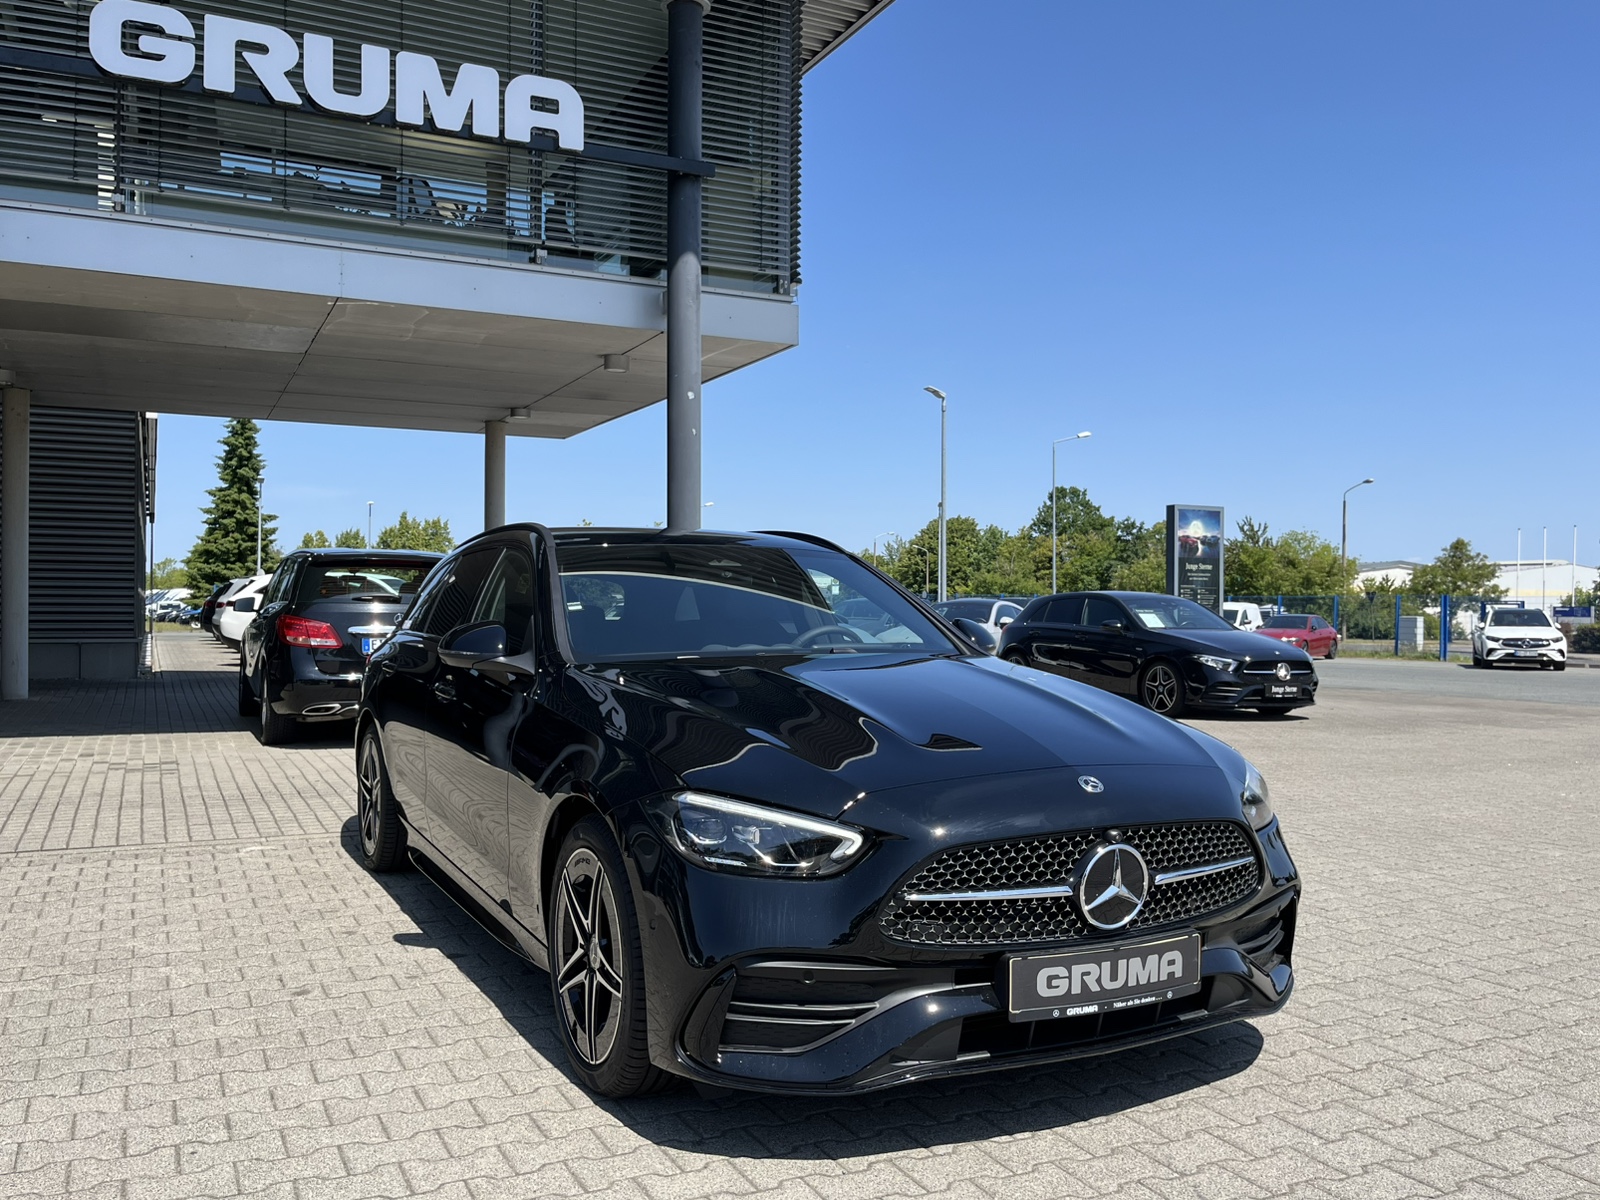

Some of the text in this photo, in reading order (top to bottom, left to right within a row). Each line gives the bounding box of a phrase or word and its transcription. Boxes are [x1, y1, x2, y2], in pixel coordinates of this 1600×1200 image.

[89, 0, 584, 151] GRUMA
[1037, 950, 1183, 997] GRUMA
[1067, 1005, 1098, 1015] GRUMA
